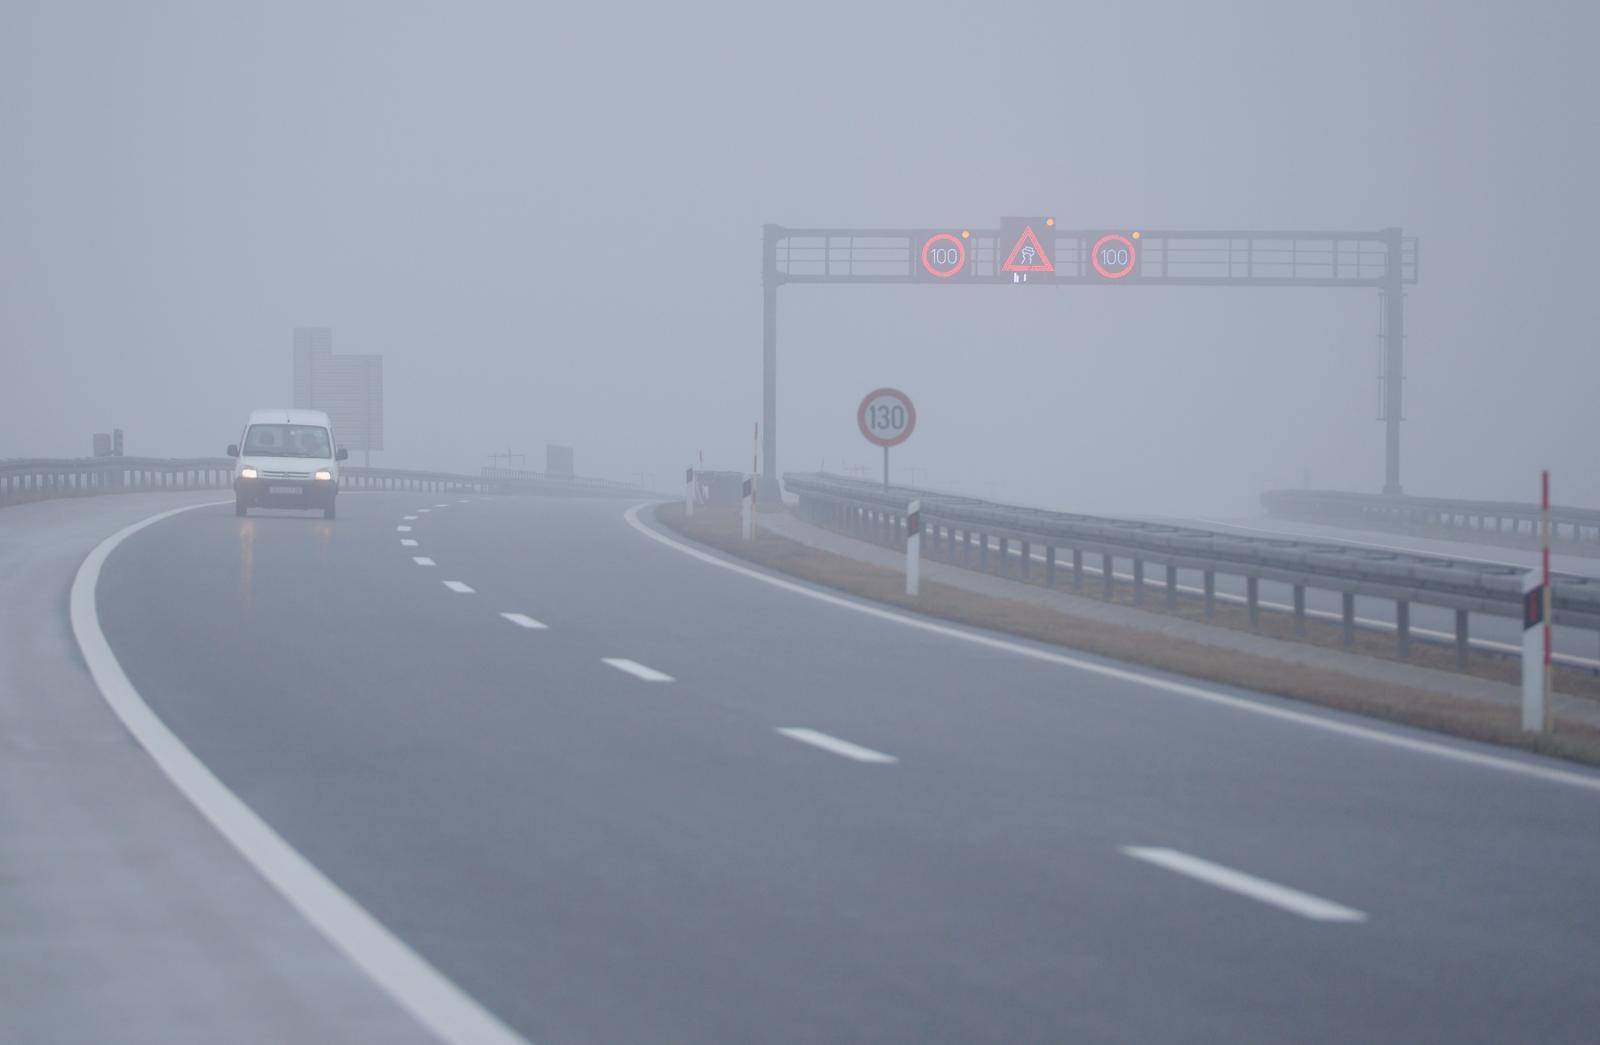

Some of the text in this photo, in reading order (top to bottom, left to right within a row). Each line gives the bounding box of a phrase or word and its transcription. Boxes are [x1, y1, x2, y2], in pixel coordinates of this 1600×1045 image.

[930, 249, 958, 264] 100
[1101, 249, 1128, 265] 100
[869, 404, 904, 429] 130
